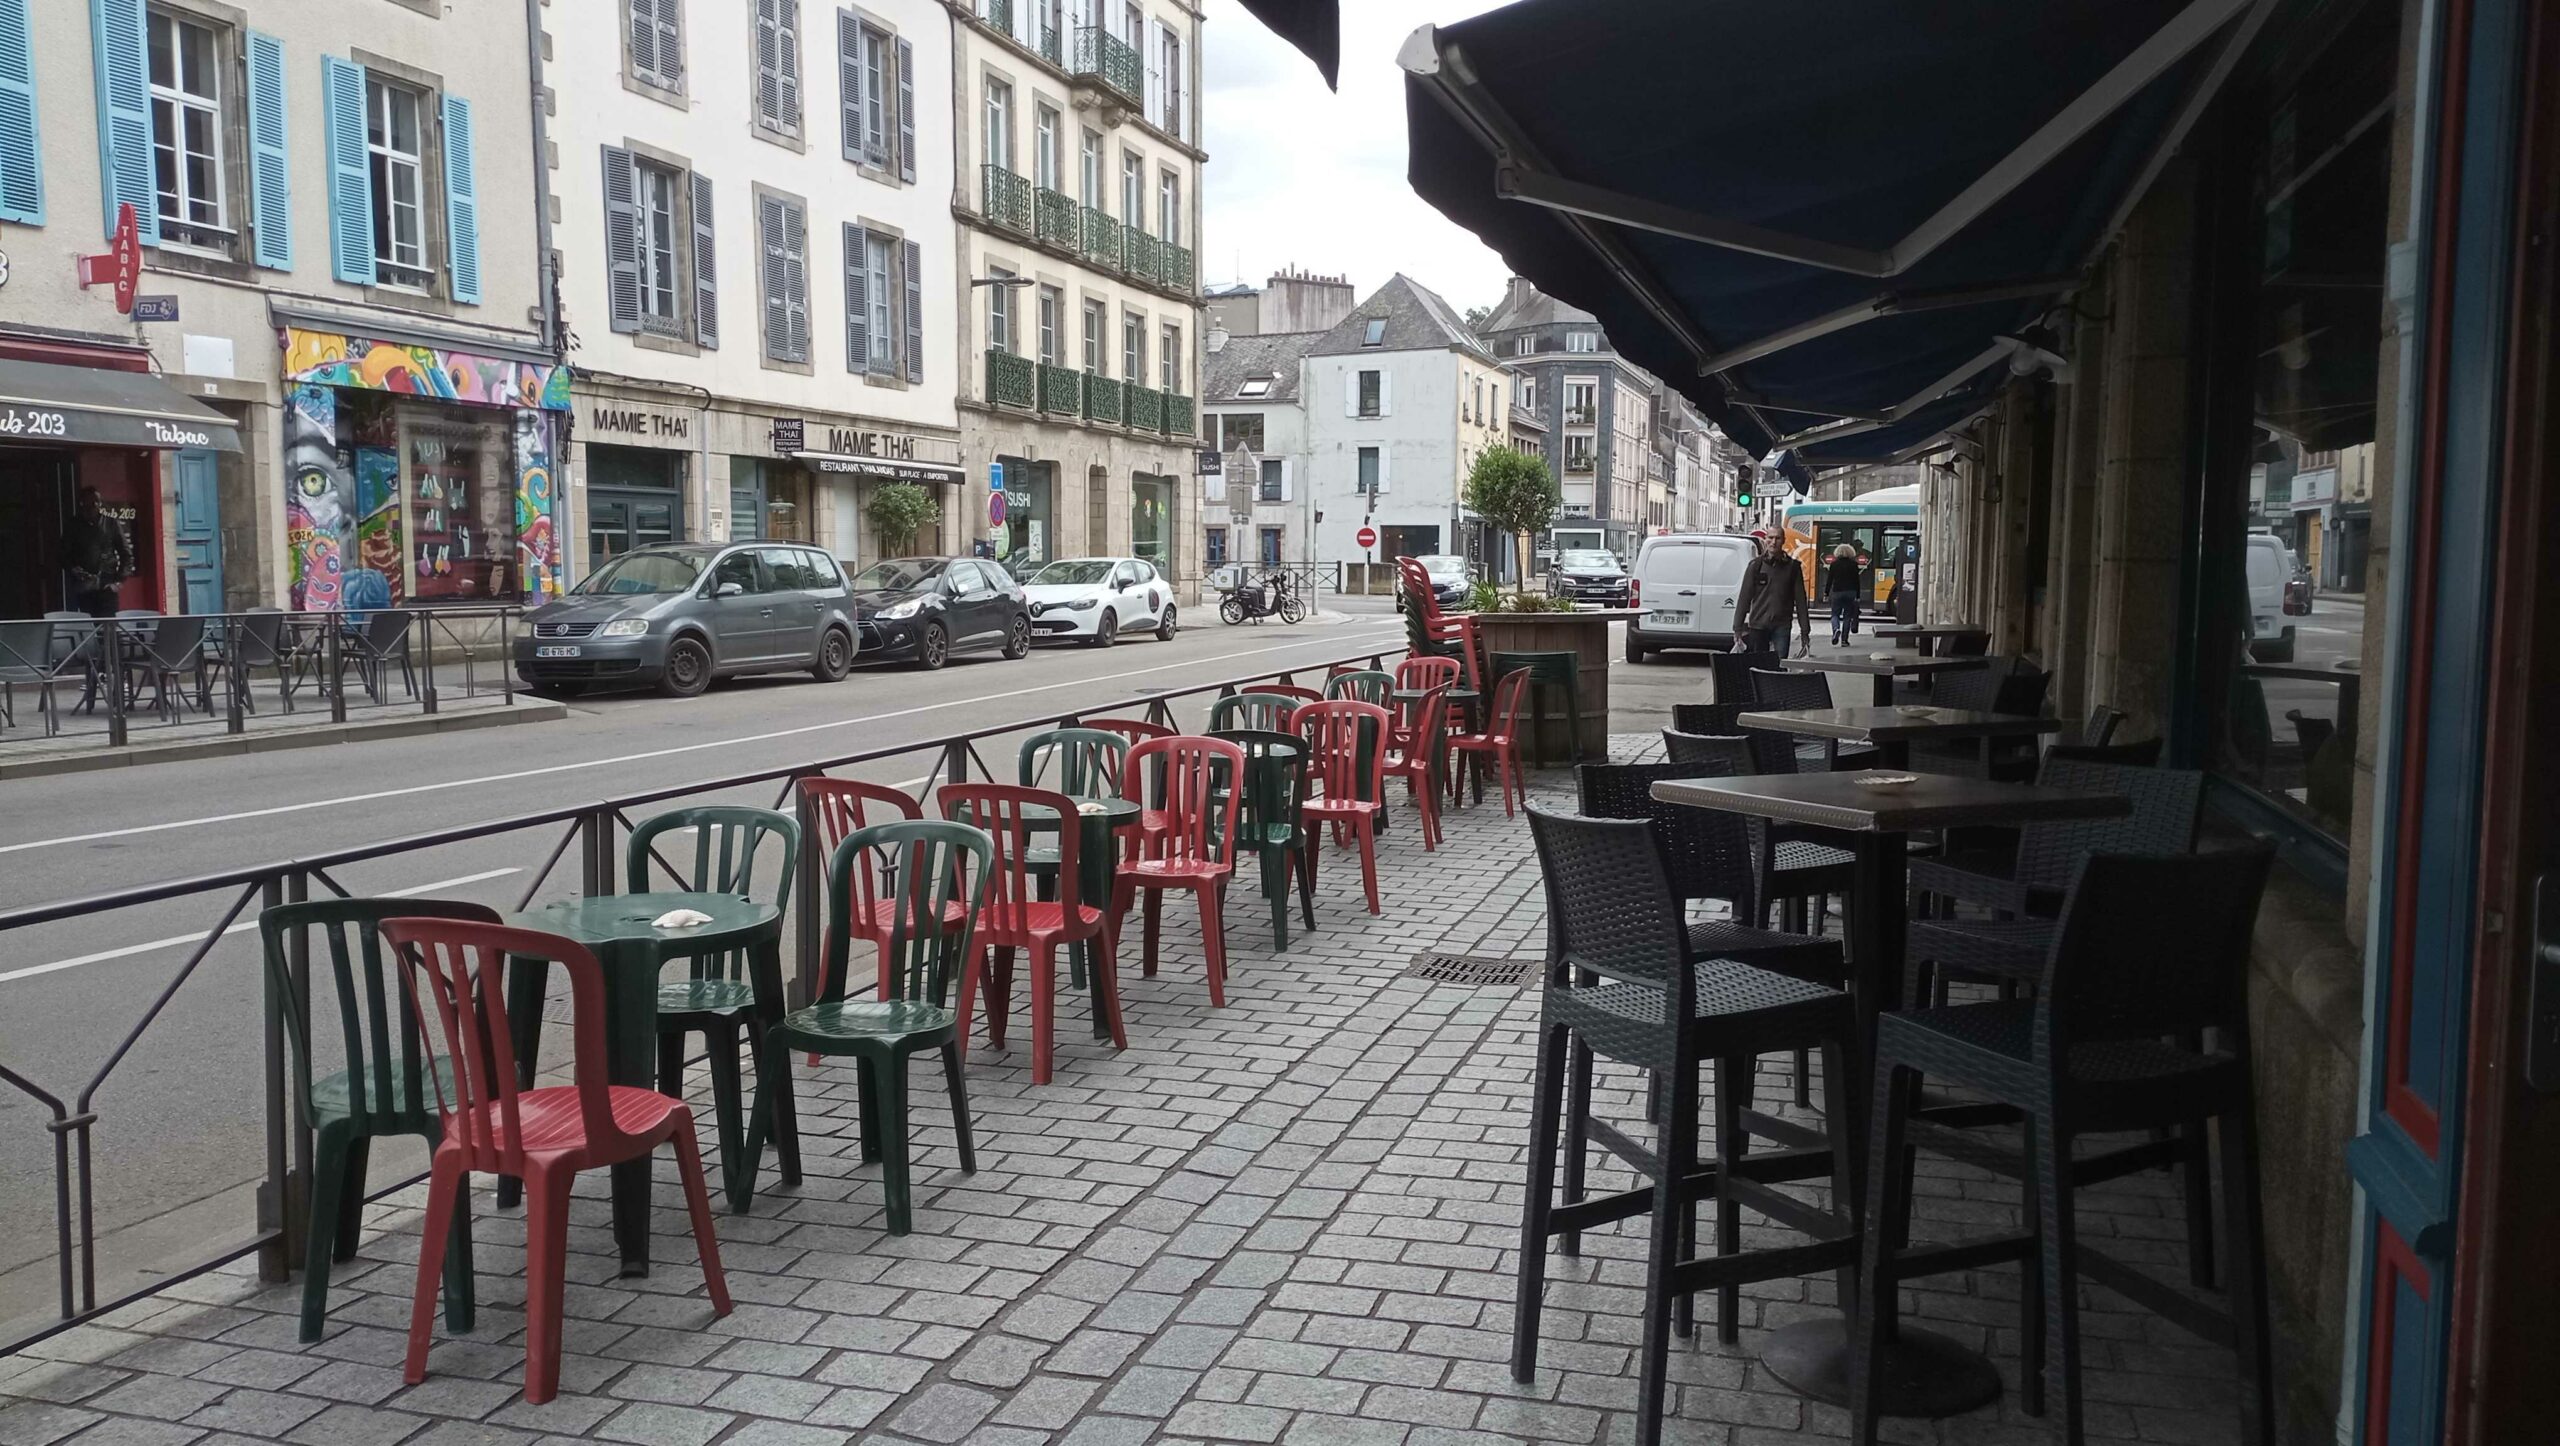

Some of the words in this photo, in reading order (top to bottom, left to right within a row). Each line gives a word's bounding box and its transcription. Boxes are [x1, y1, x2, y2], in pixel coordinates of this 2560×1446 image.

[118, 225, 129, 292] TABAC
[140, 303, 157, 314] FDJ
[28, 411, 65, 435] 203
[593, 408, 647, 434] MAMIE
[775, 421, 802, 430] MAMIE
[145, 421, 209, 445] Tabac
[829, 428, 877, 456] MAMIE
[820, 460, 861, 473] RESTAURANT
[1007, 491, 1031, 508] SUSHI
[119, 508, 136, 520] 203
[1906, 545, 1915, 557] P
